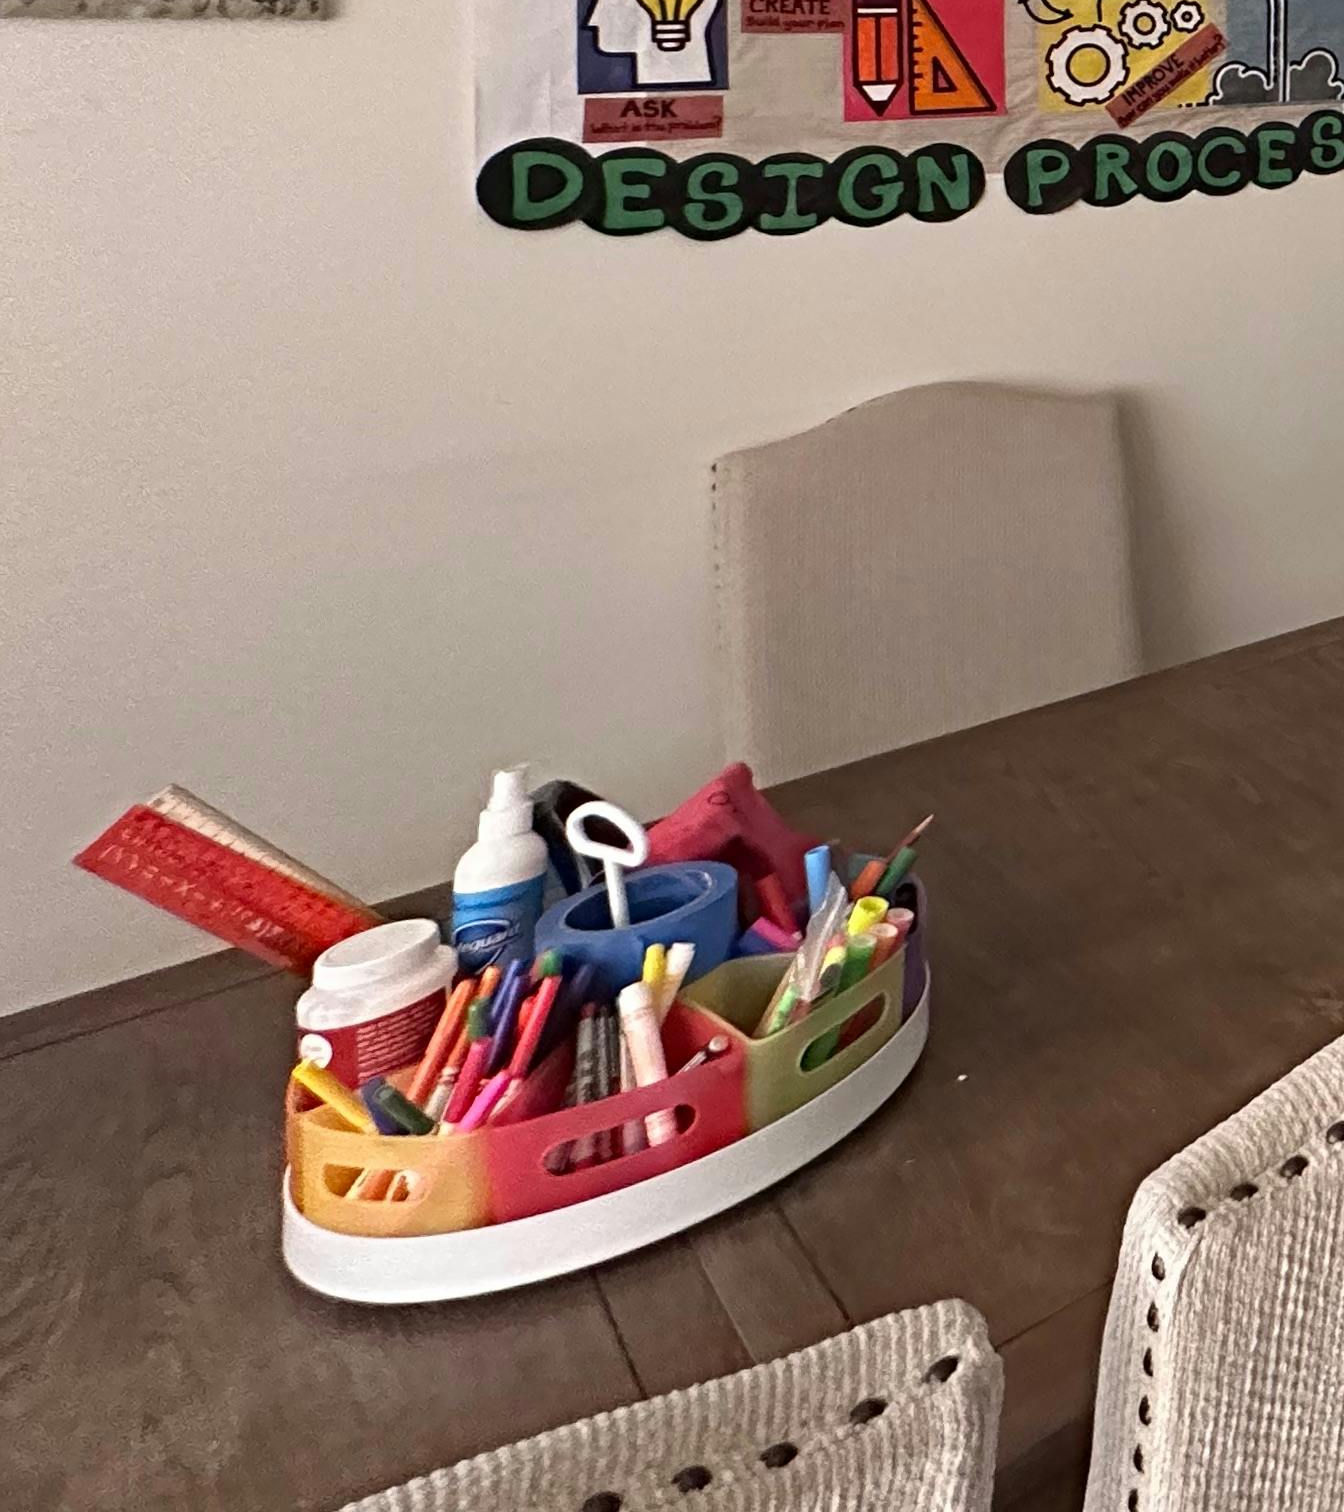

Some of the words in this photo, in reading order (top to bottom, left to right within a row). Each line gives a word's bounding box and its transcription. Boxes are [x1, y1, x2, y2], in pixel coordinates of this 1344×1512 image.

[1121, 53, 1184, 106] IMPROVE
[620, 99, 677, 118] ASK
[511, 150, 970, 232] DESIGN
